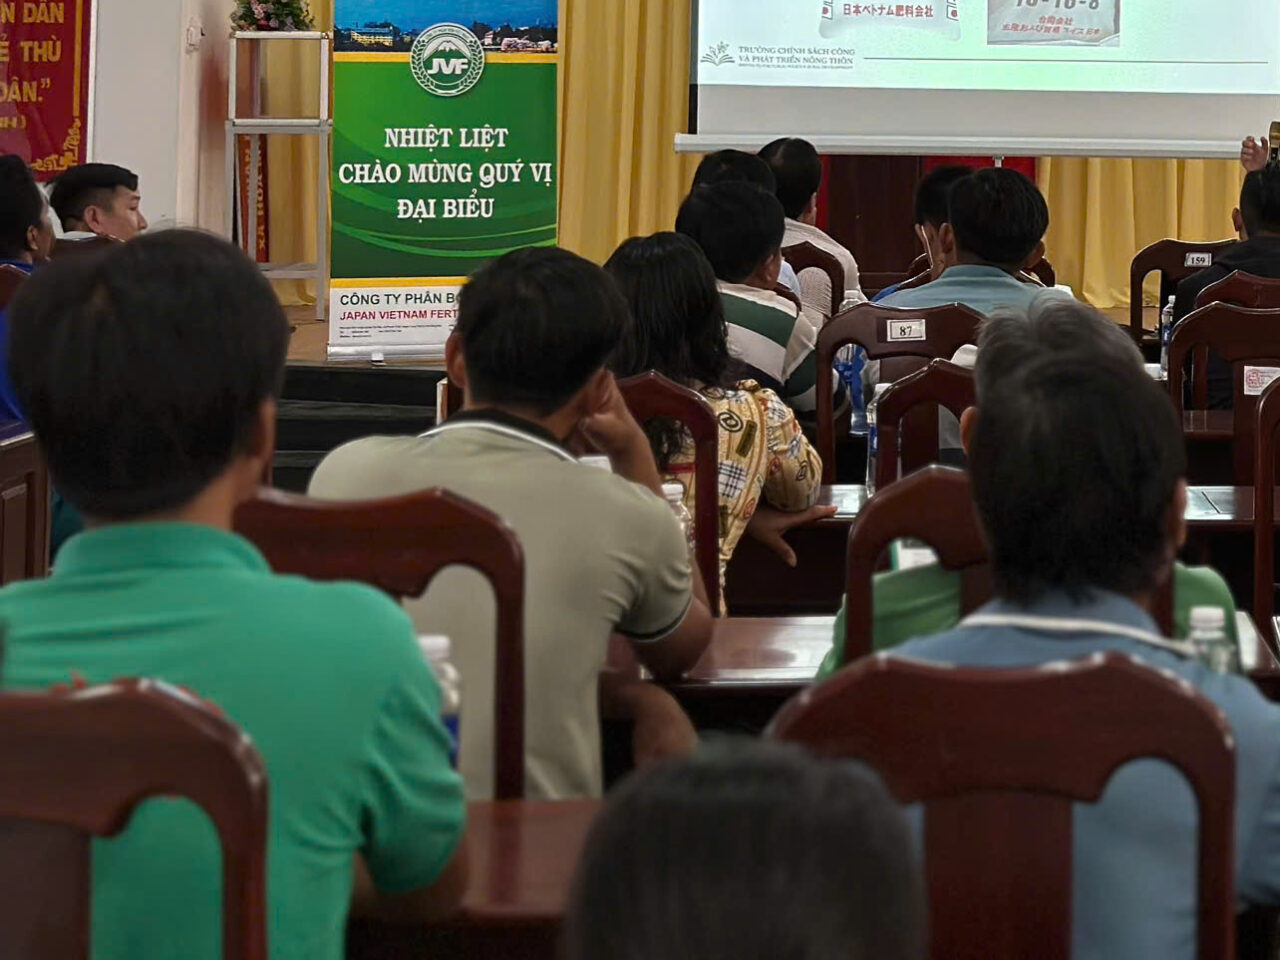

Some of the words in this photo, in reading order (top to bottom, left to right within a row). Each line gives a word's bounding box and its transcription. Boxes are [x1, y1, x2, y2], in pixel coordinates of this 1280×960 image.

[20, 36, 62, 63] THÙ
[427, 58, 469, 74] JVF
[384, 124, 453, 152] NHIỆT
[458, 124, 509, 152] LIỆT
[338, 158, 401, 184] CHÀO
[408, 158, 472, 184] MỪNG
[478, 158, 524, 188] QUÝ
[530, 163, 552, 187] VỊ
[397, 198, 436, 223] ĐẠI
[442, 188, 494, 218] BIỂU
[1190, 255, 1206, 265] 159
[340, 292, 380, 305] CÔNG
[384, 294, 402, 304] TY
[405, 291, 442, 304] PHÂN
[340, 311, 376, 320] JAPAN
[379, 310, 427, 320] VIETNAM
[899, 325, 913, 336] 87
